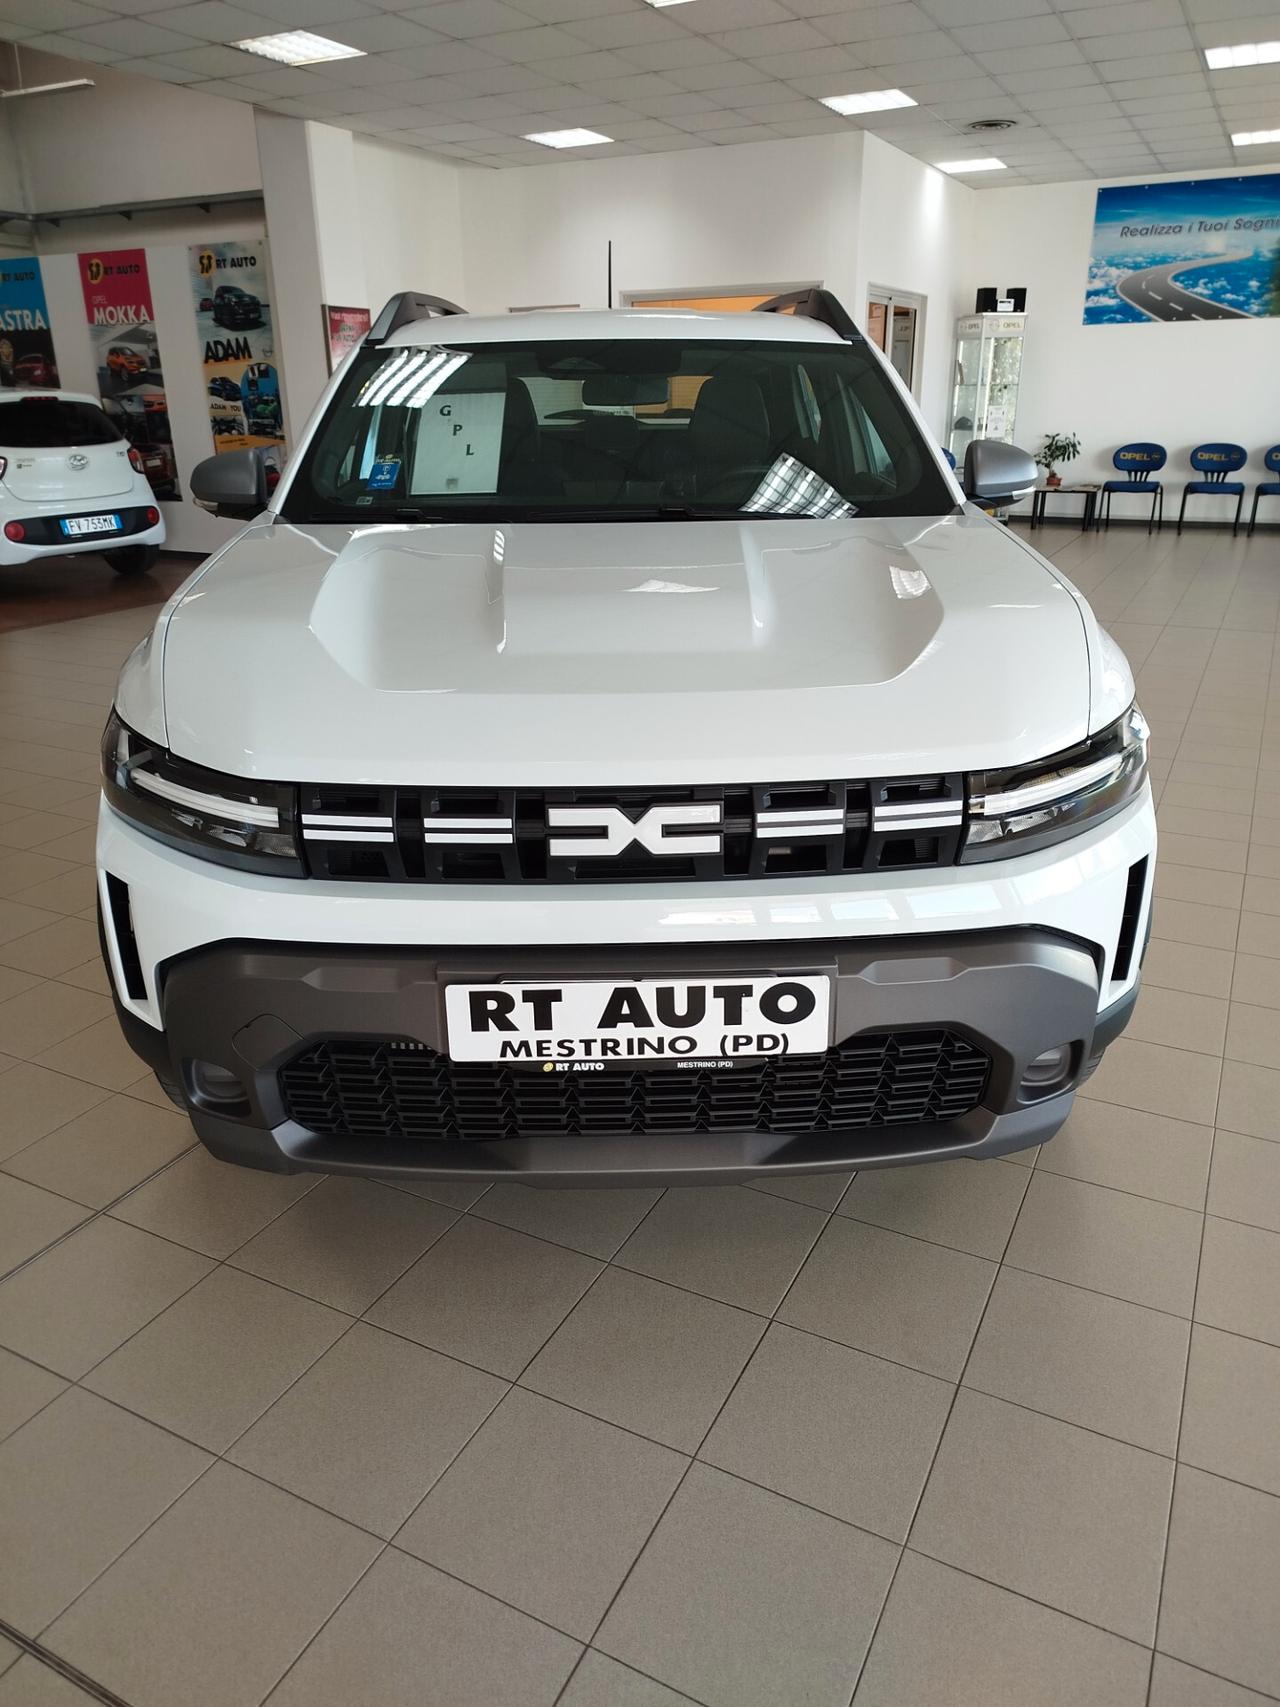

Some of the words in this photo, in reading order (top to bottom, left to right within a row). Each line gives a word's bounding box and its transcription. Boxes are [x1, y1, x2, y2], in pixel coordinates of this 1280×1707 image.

[1120, 224, 1183, 238] Realizza
[1198, 220, 1229, 233] Tuoi
[216, 258, 228, 269] RT
[230, 256, 257, 268] AUTO
[116, 263, 140, 275] AUTO
[14, 271, 35, 281] AUTO
[93, 304, 150, 325] MOKKA
[204, 336, 252, 363] ADAM
[1119, 452, 1150, 461] OPEL
[1197, 452, 1228, 461] OPEL
[468, 989, 563, 1032] RT
[596, 982, 816, 1029] AUTO
[500, 1035, 698, 1058] MESTRINO
[719, 1033, 789, 1057] (PD)
[555, 1062, 569, 1071] RT
[573, 1061, 605, 1071] AUTO
[677, 1061, 717, 1069] MESTRINO
[717, 1061, 734, 1069] (PD)
